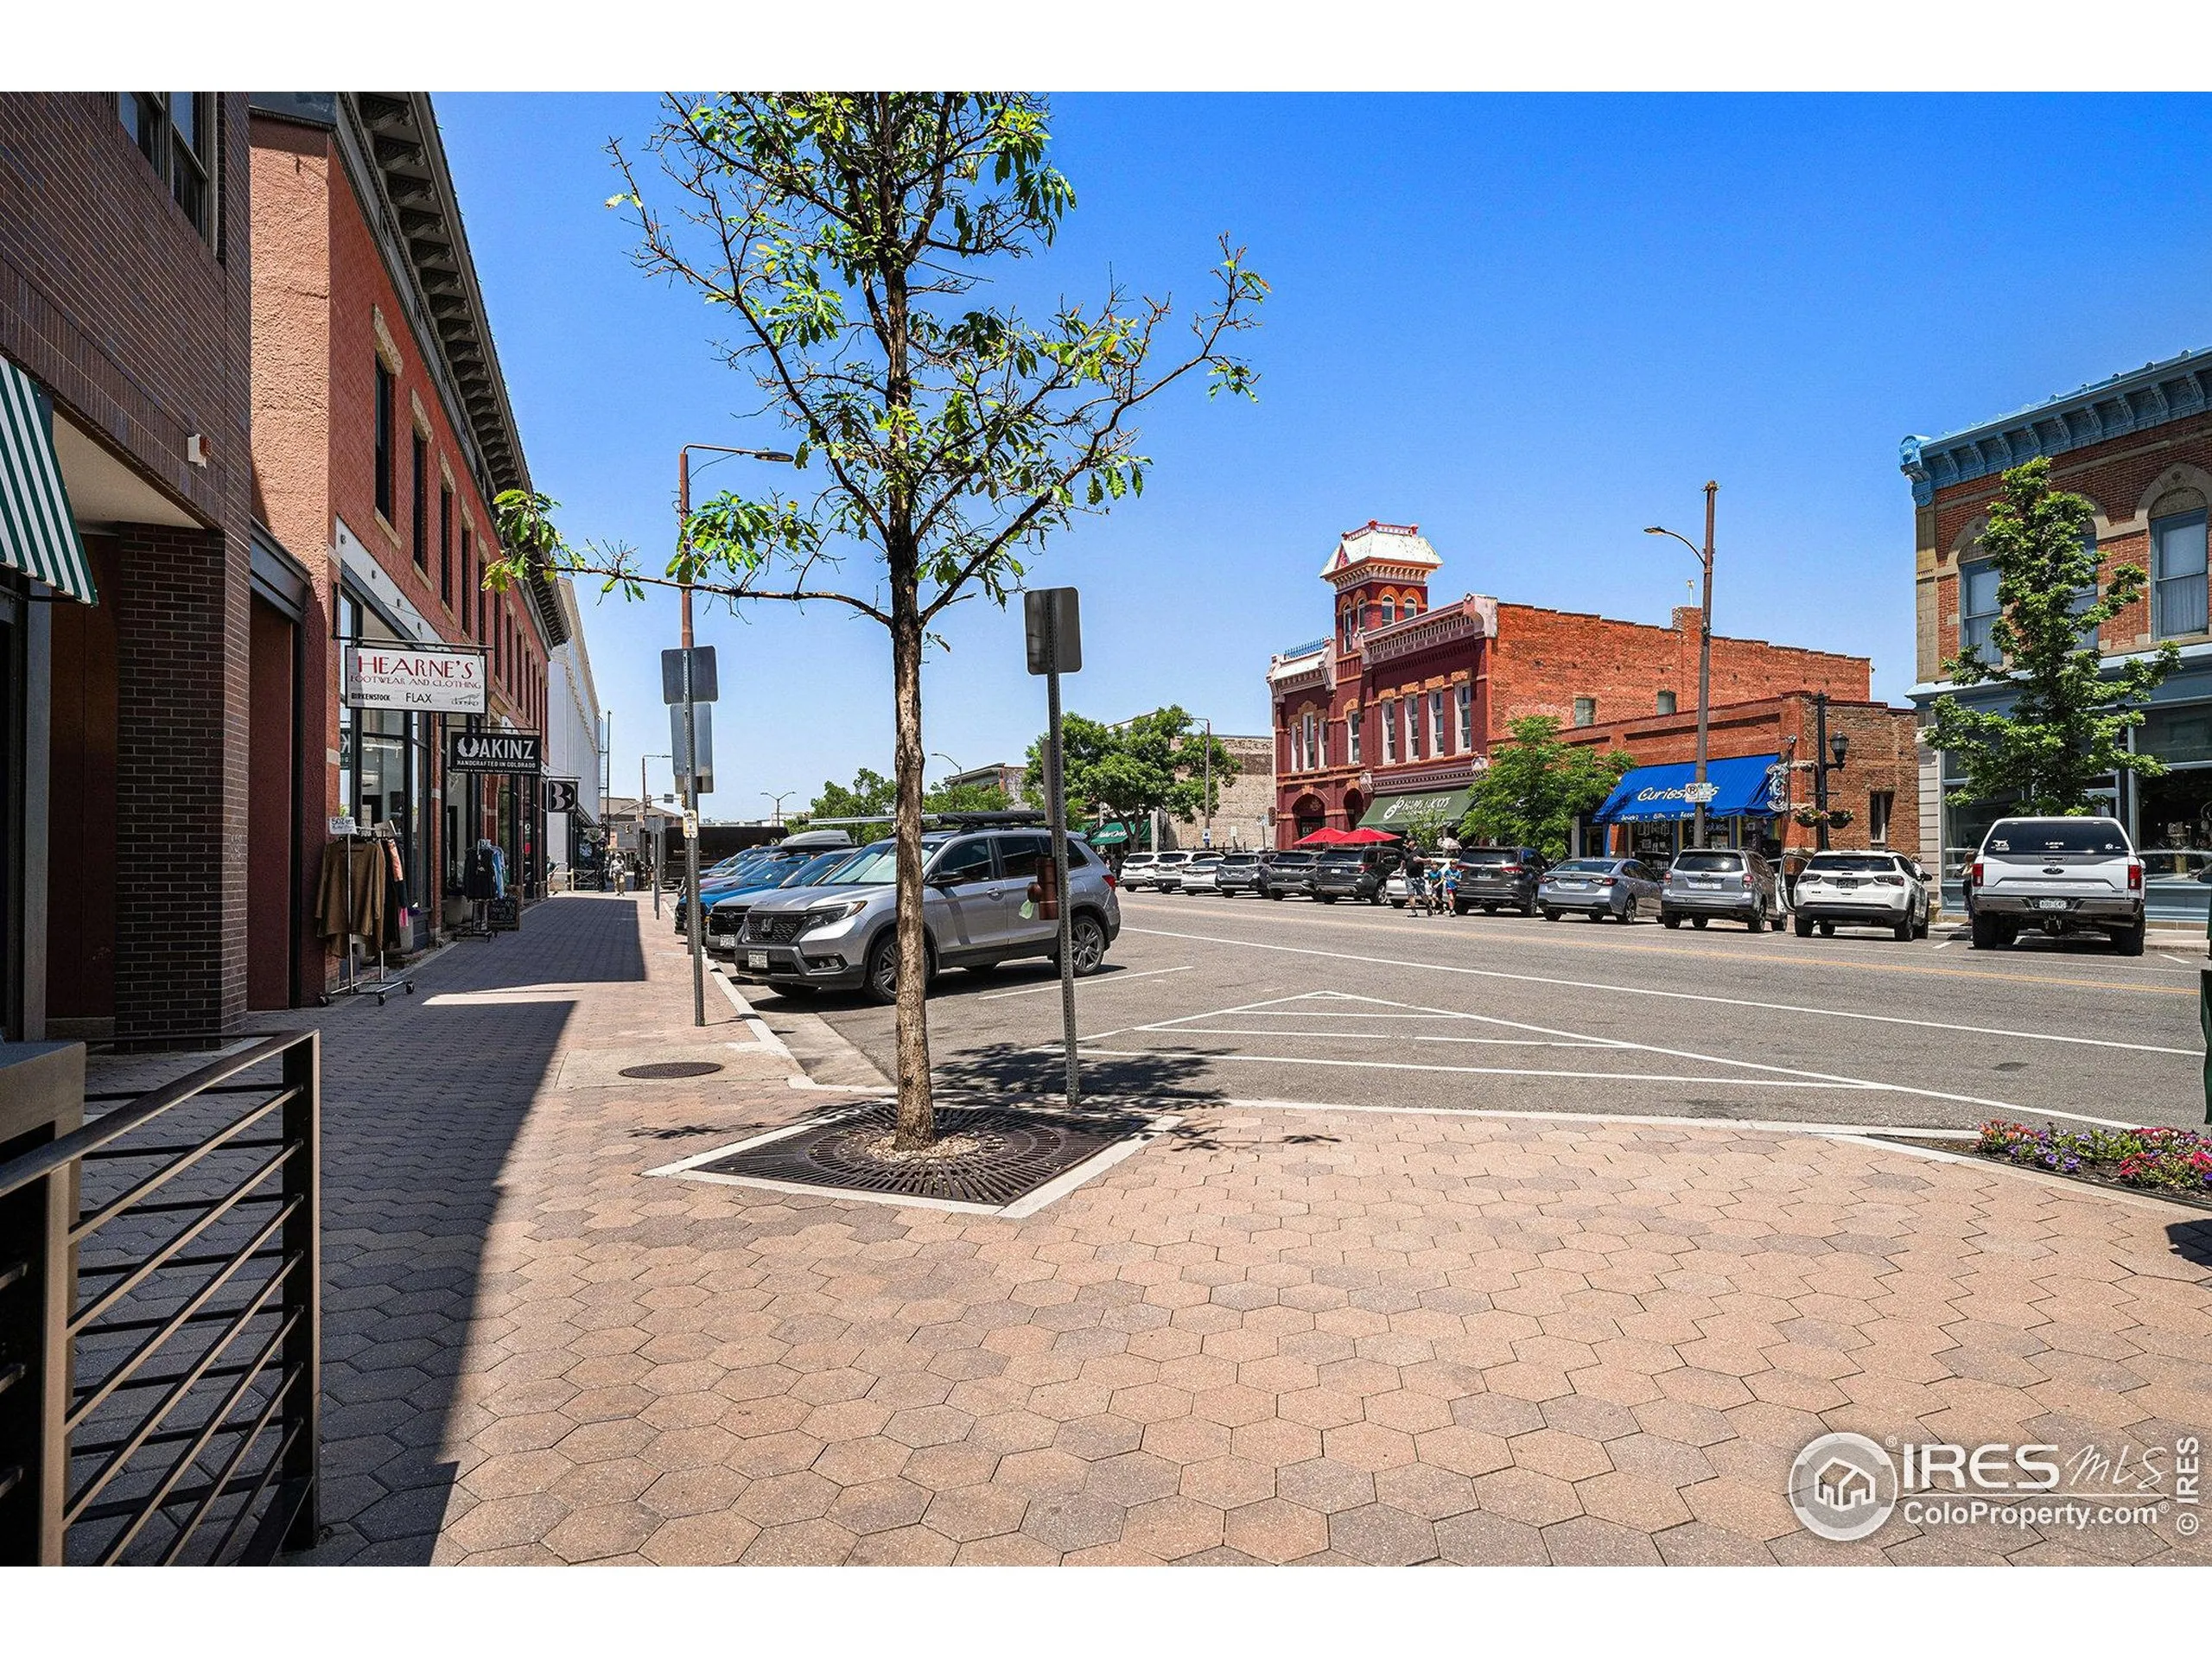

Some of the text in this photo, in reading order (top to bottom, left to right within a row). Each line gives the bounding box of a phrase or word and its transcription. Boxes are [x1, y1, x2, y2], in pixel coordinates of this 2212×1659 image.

[358, 655, 474, 679] HEARNE'S
[350, 674, 405, 685] FOOTWEAR
[432, 679, 482, 690] CLOTHING
[351, 692, 391, 702] BIRKENSTOCK
[405, 692, 432, 703] FLAX
[479, 738, 535, 760] AKINZ
